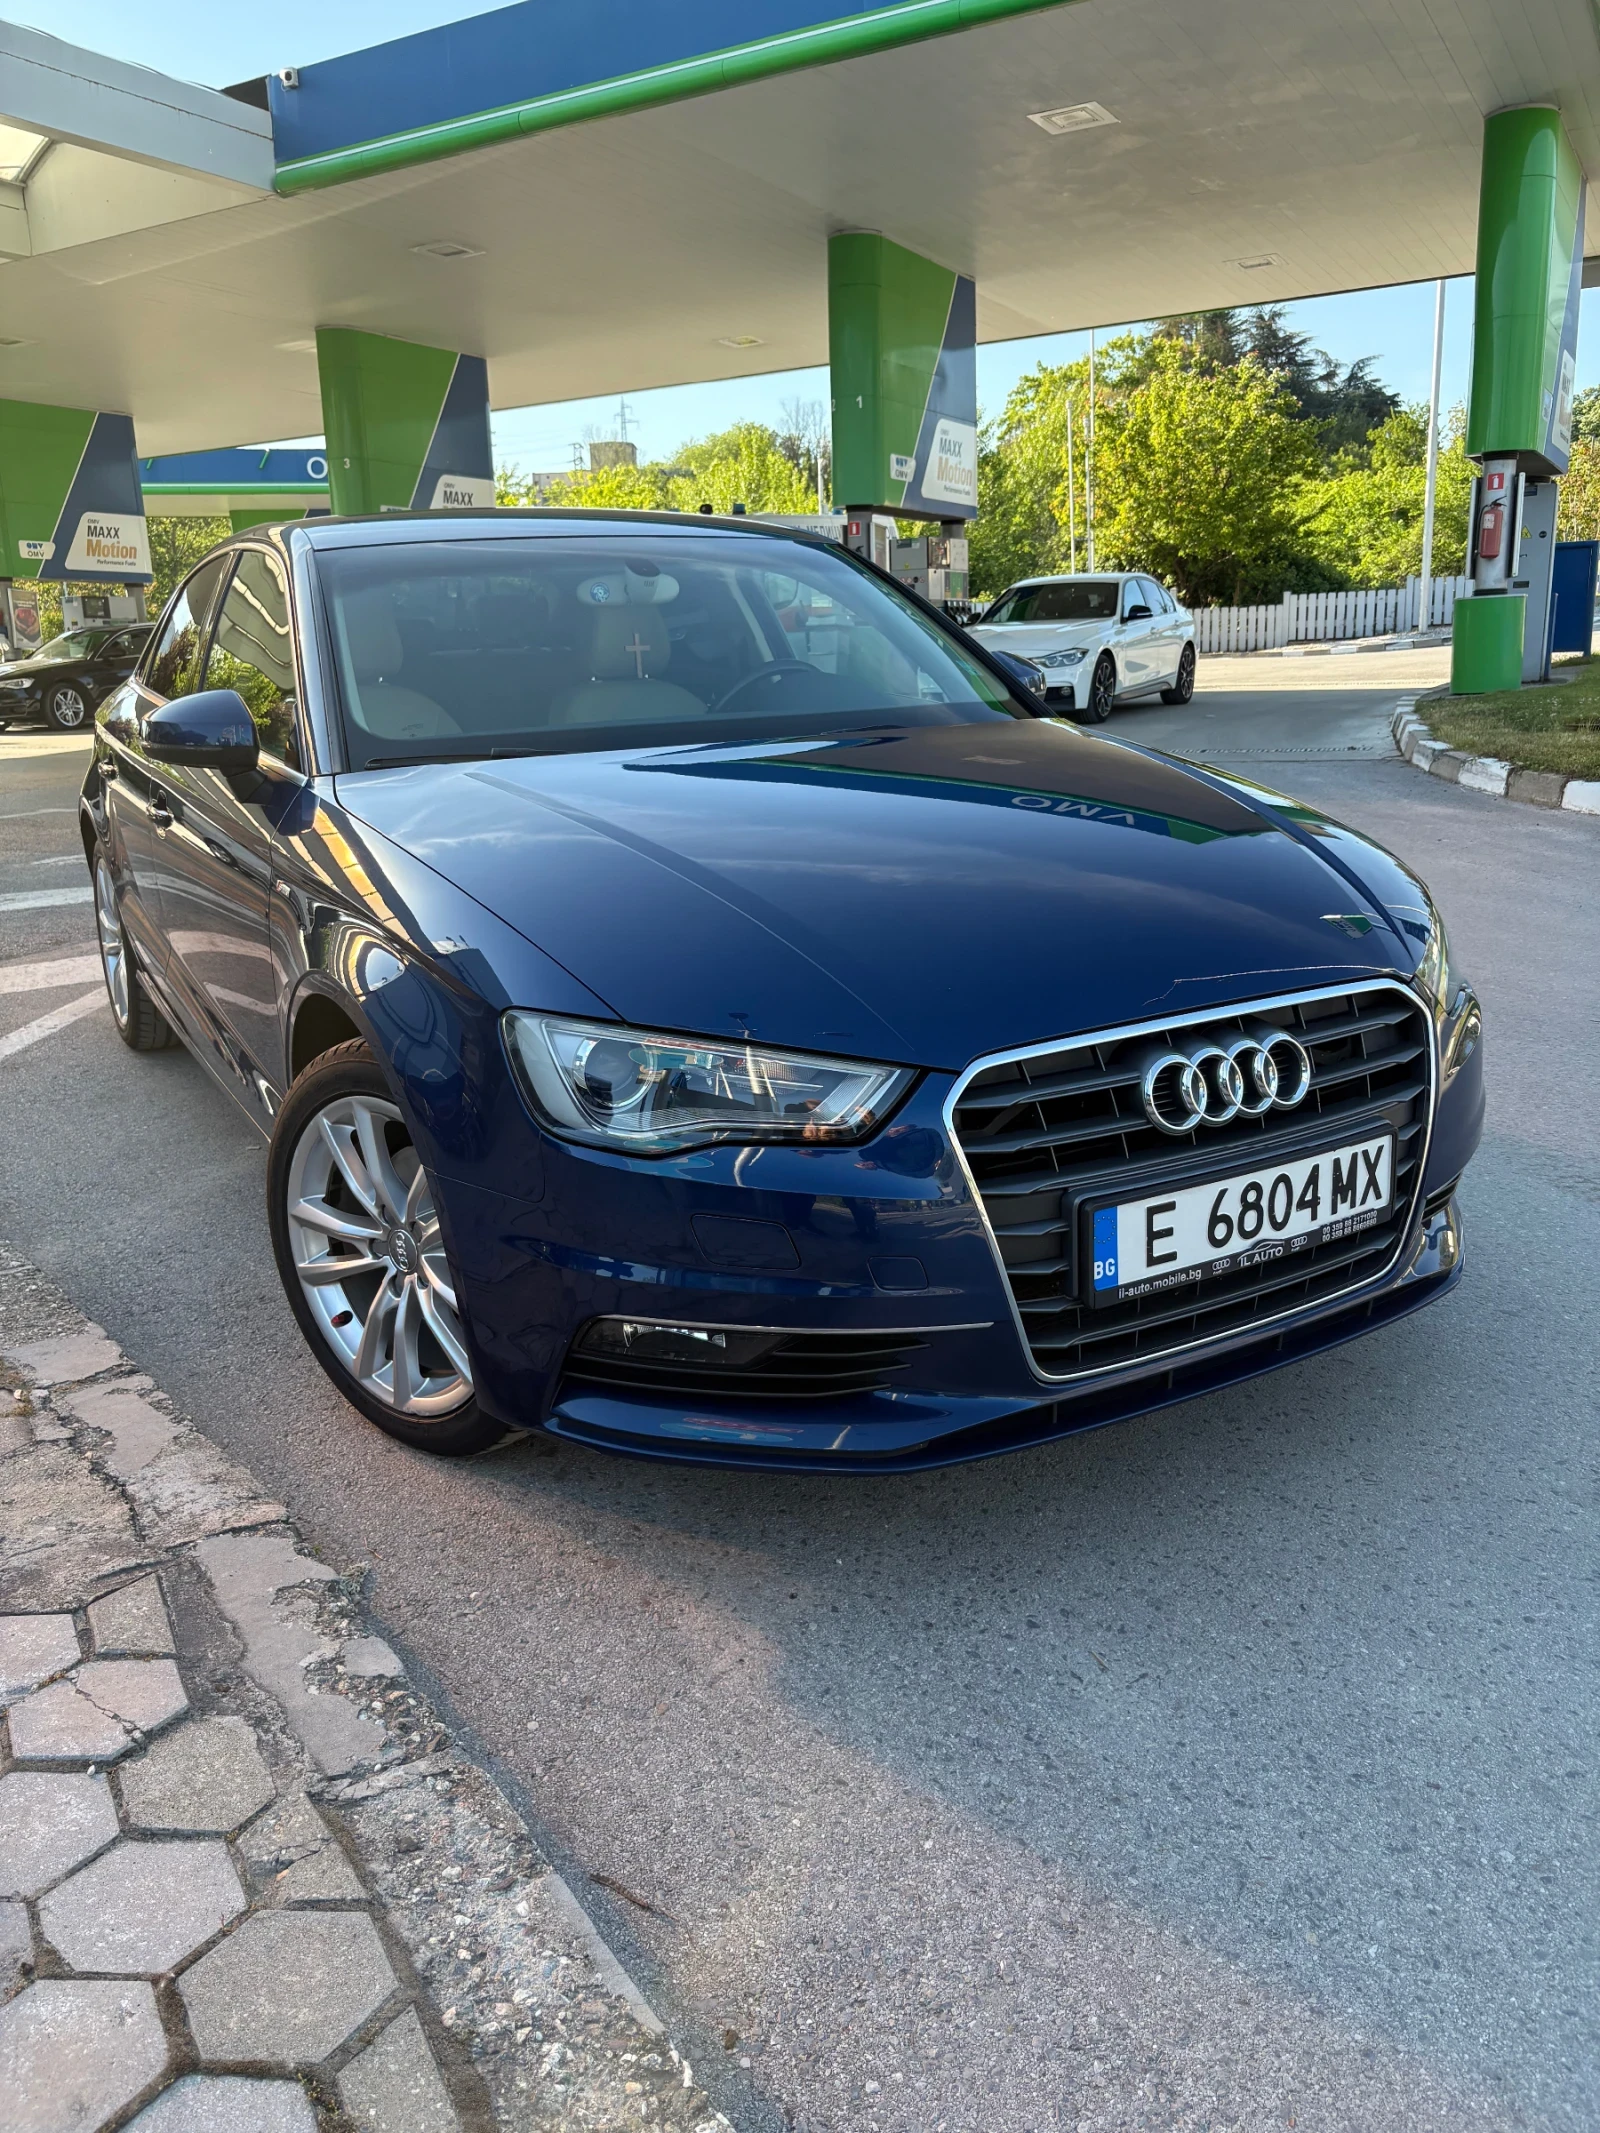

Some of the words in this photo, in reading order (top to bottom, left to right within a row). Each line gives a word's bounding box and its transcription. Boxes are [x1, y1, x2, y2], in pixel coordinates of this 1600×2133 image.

[855, 395, 863, 409] 1
[939, 437, 962, 459] MAXX
[343, 457, 351, 469] 3
[937, 456, 973, 487] Motion
[442, 490, 473, 507] MAXX
[87, 525, 120, 539] MAXX
[27, 550, 45, 558] OMV
[86, 539, 138, 560] Motion
[1146, 1199, 1178, 1268] E
[1207, 1163, 1321, 1249] 6804
[1330, 1144, 1385, 1216] MX
[1240, 1257, 1251, 1268] IL
[1252, 1246, 1284, 1264] AUTO
[1093, 1257, 1116, 1281] BG
[1118, 1268, 1202, 1299] il-auto.mobile.bg
